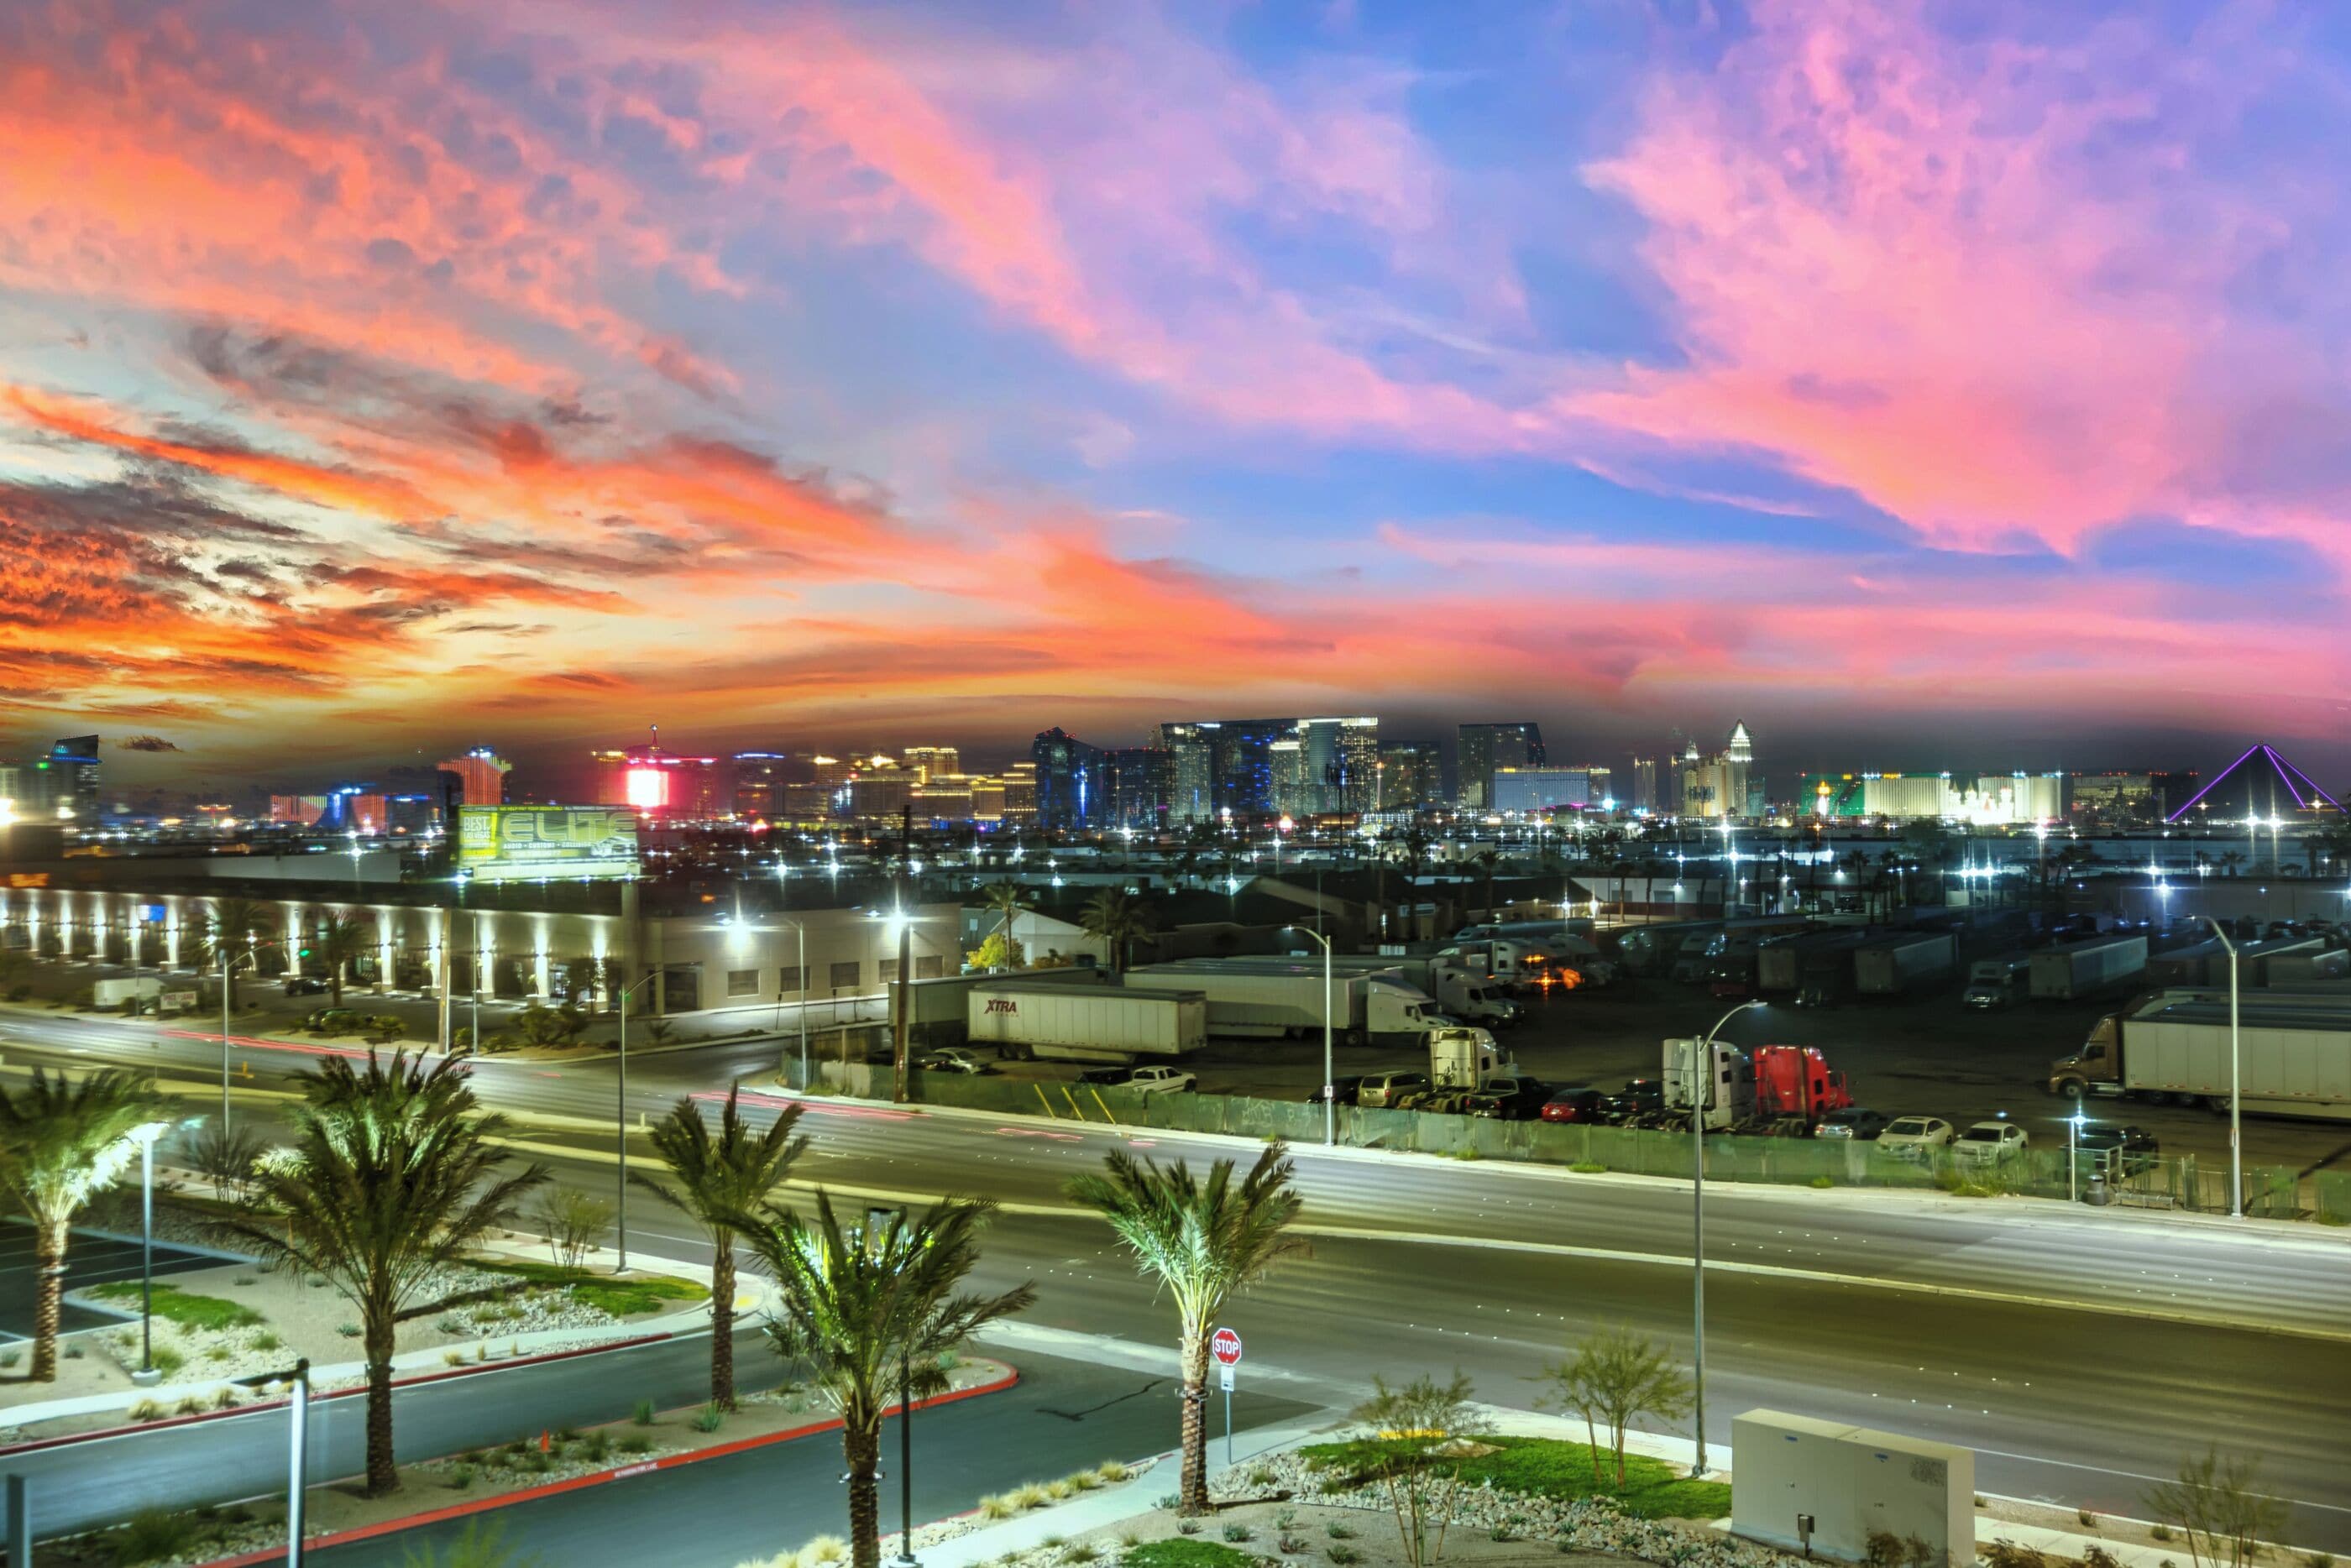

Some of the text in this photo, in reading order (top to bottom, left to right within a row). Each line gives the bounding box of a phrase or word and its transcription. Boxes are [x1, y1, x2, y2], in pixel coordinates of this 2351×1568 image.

[463, 816, 490, 831] BEST
[503, 813, 636, 842] ELITE
[984, 999, 1017, 1014] XTRA
[1215, 1339, 1238, 1356] STOP
